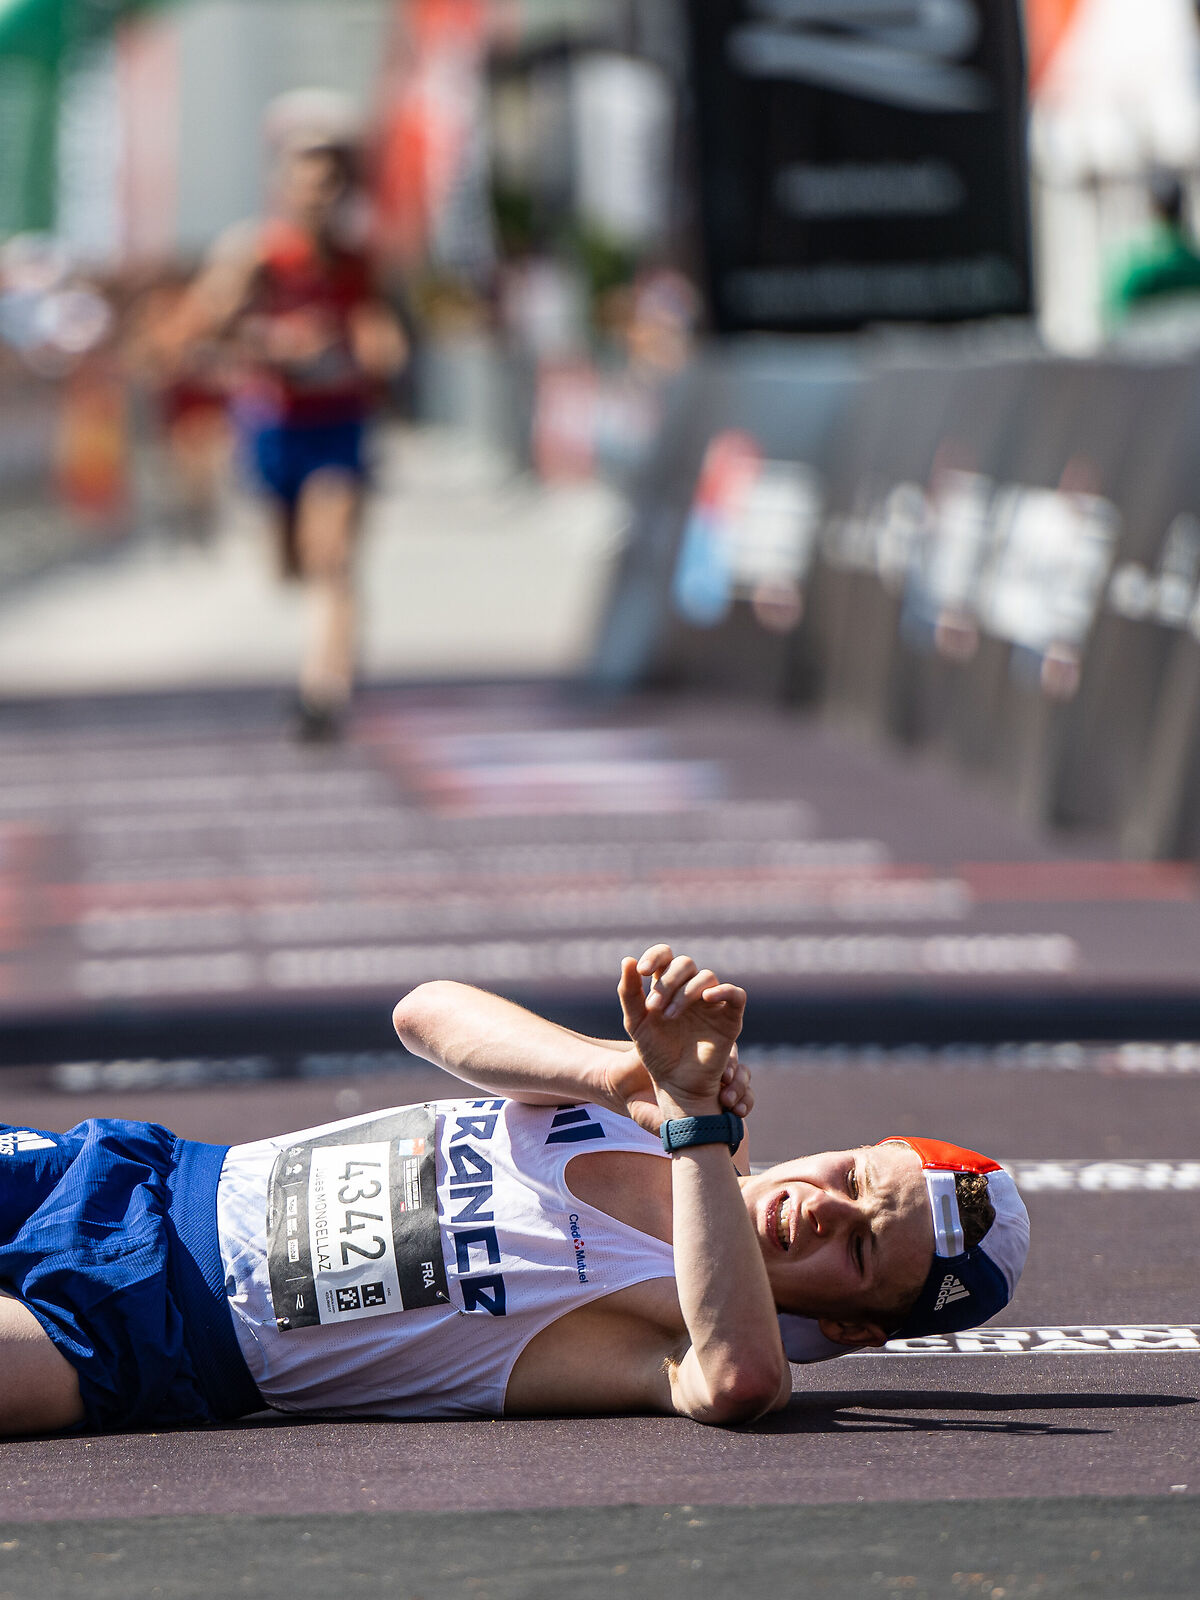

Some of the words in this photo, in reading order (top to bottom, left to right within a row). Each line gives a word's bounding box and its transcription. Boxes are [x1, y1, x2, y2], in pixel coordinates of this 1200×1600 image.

[338, 1160, 386, 1266] 4342
[313, 1193, 333, 1273] MONGELLAZ
[421, 1261, 435, 1288] FRA
[575, 1250, 589, 1284] Mutuel
[933, 1274, 954, 1311] adidas
